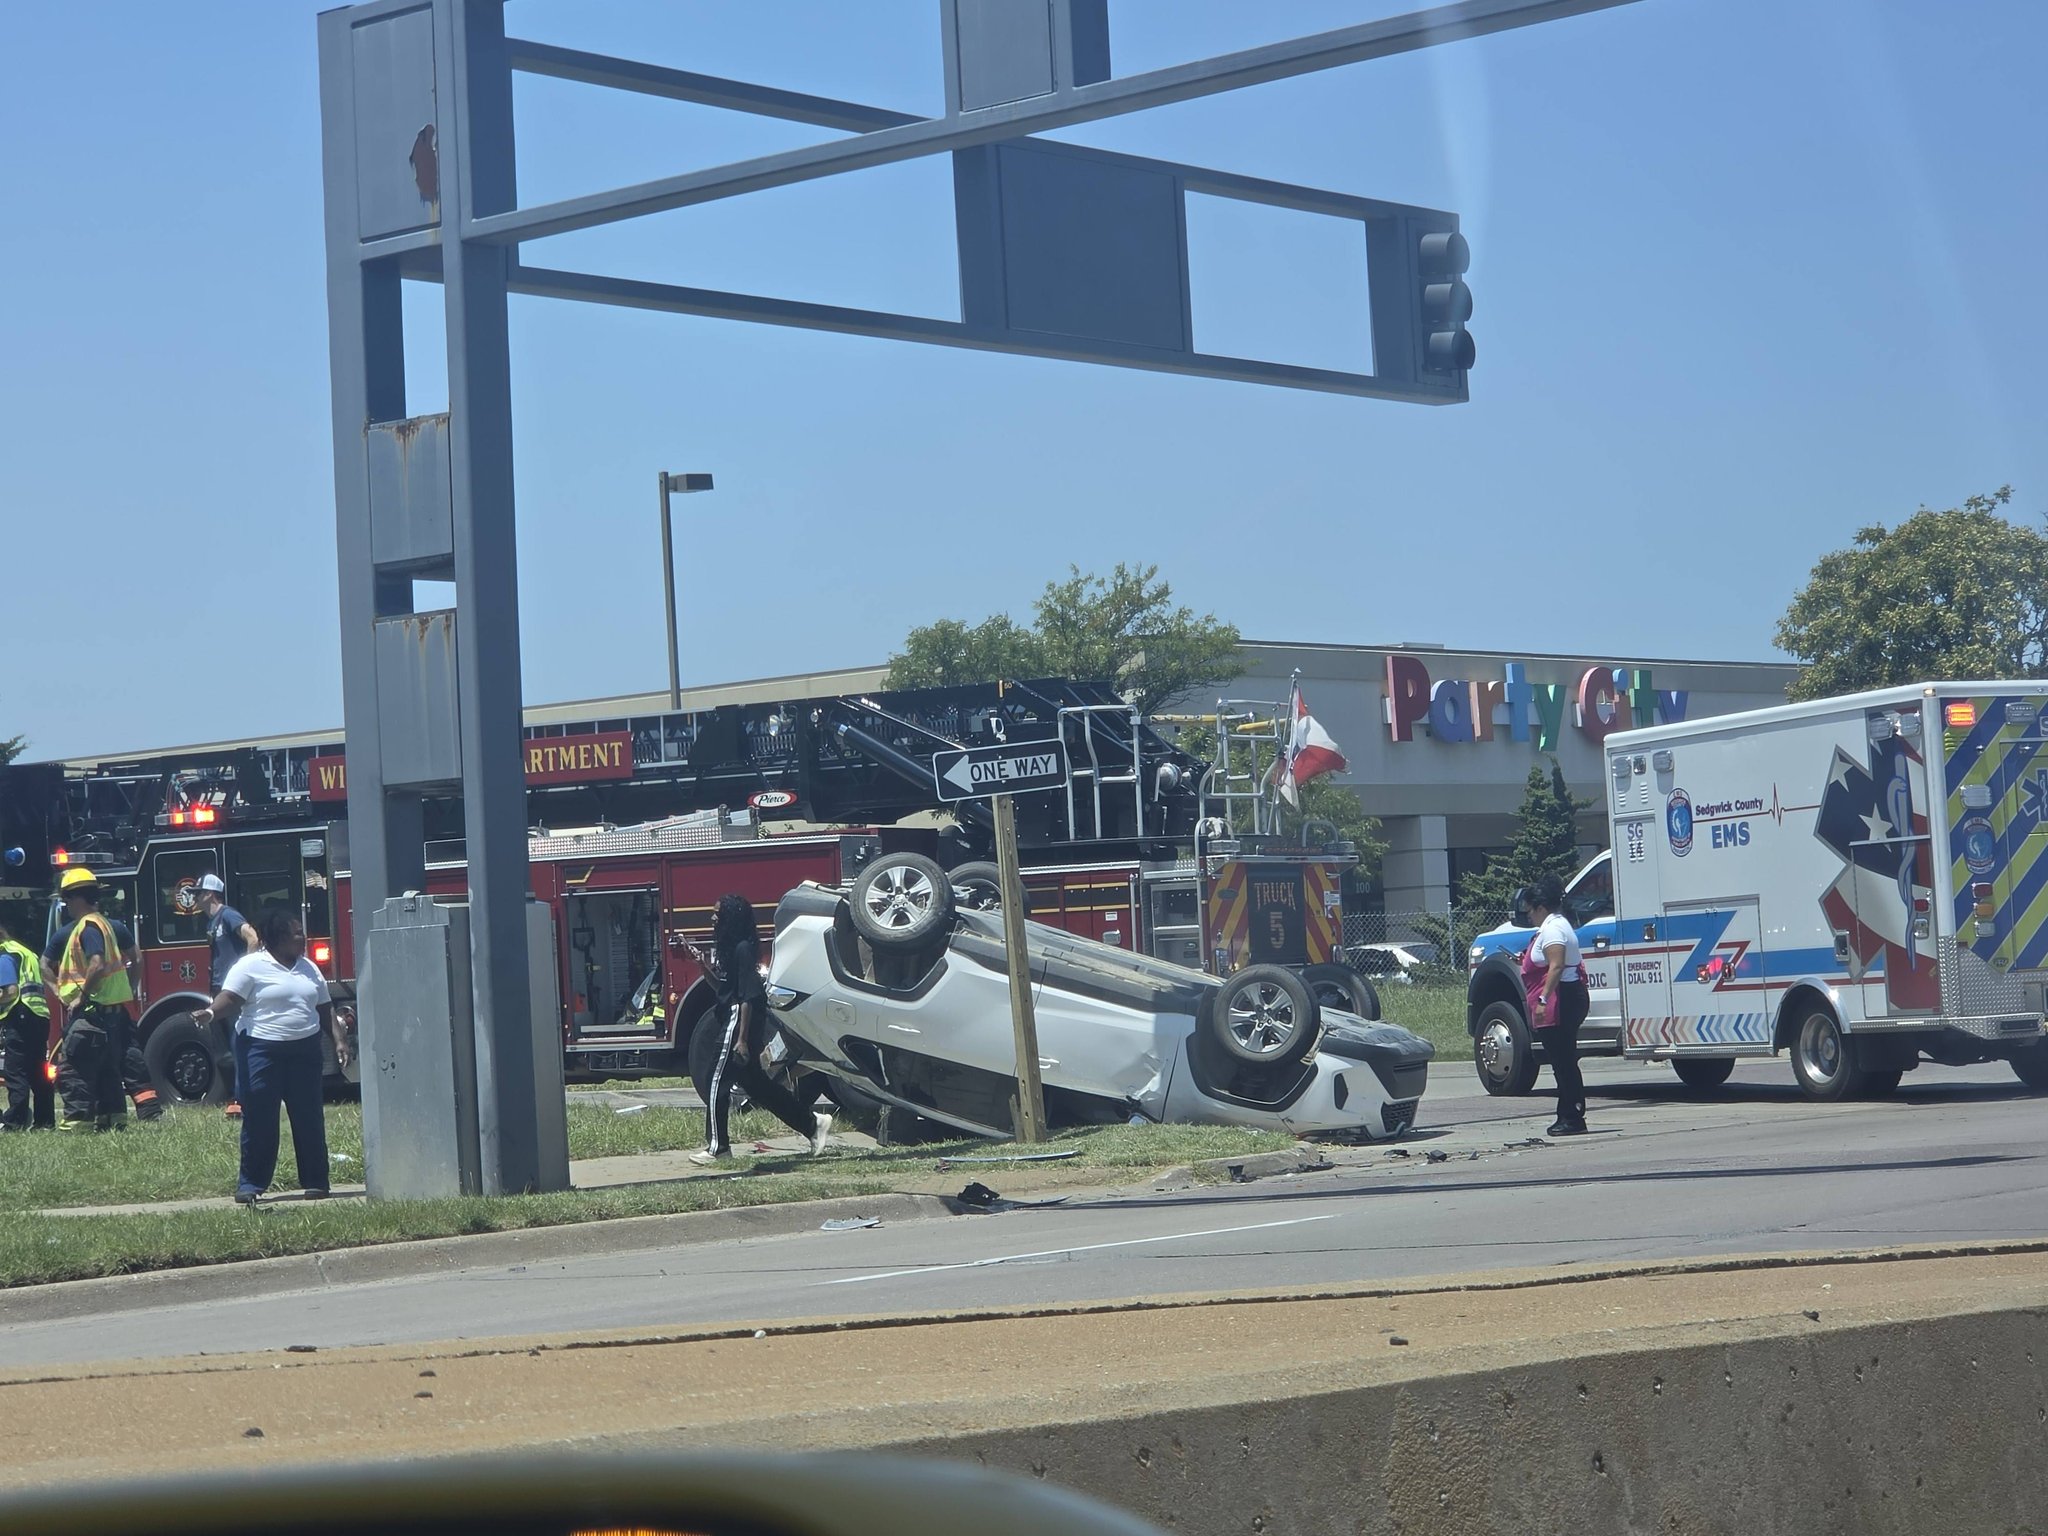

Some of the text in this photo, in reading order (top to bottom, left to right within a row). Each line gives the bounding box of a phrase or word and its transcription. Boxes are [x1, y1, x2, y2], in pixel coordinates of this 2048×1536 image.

[1386, 655, 1567, 751] Party
[319, 741, 623, 790] WI RTMENT
[970, 755, 1052, 782] ONE WAY
[758, 794, 786, 806] Pierce
[1695, 801, 1733, 817] Sedgwick
[1734, 797, 1764, 811] County
[1627, 822, 1644, 841] SG
[1711, 821, 1751, 849] EMS
[1254, 882, 1297, 911] TRUCK
[1355, 882, 1370, 894] 100
[1269, 911, 1285, 949] 5
[1627, 960, 1662, 972] EMERGENCY
[1586, 973, 1608, 988] DIC
[1628, 971, 1664, 985] DIAL 911
